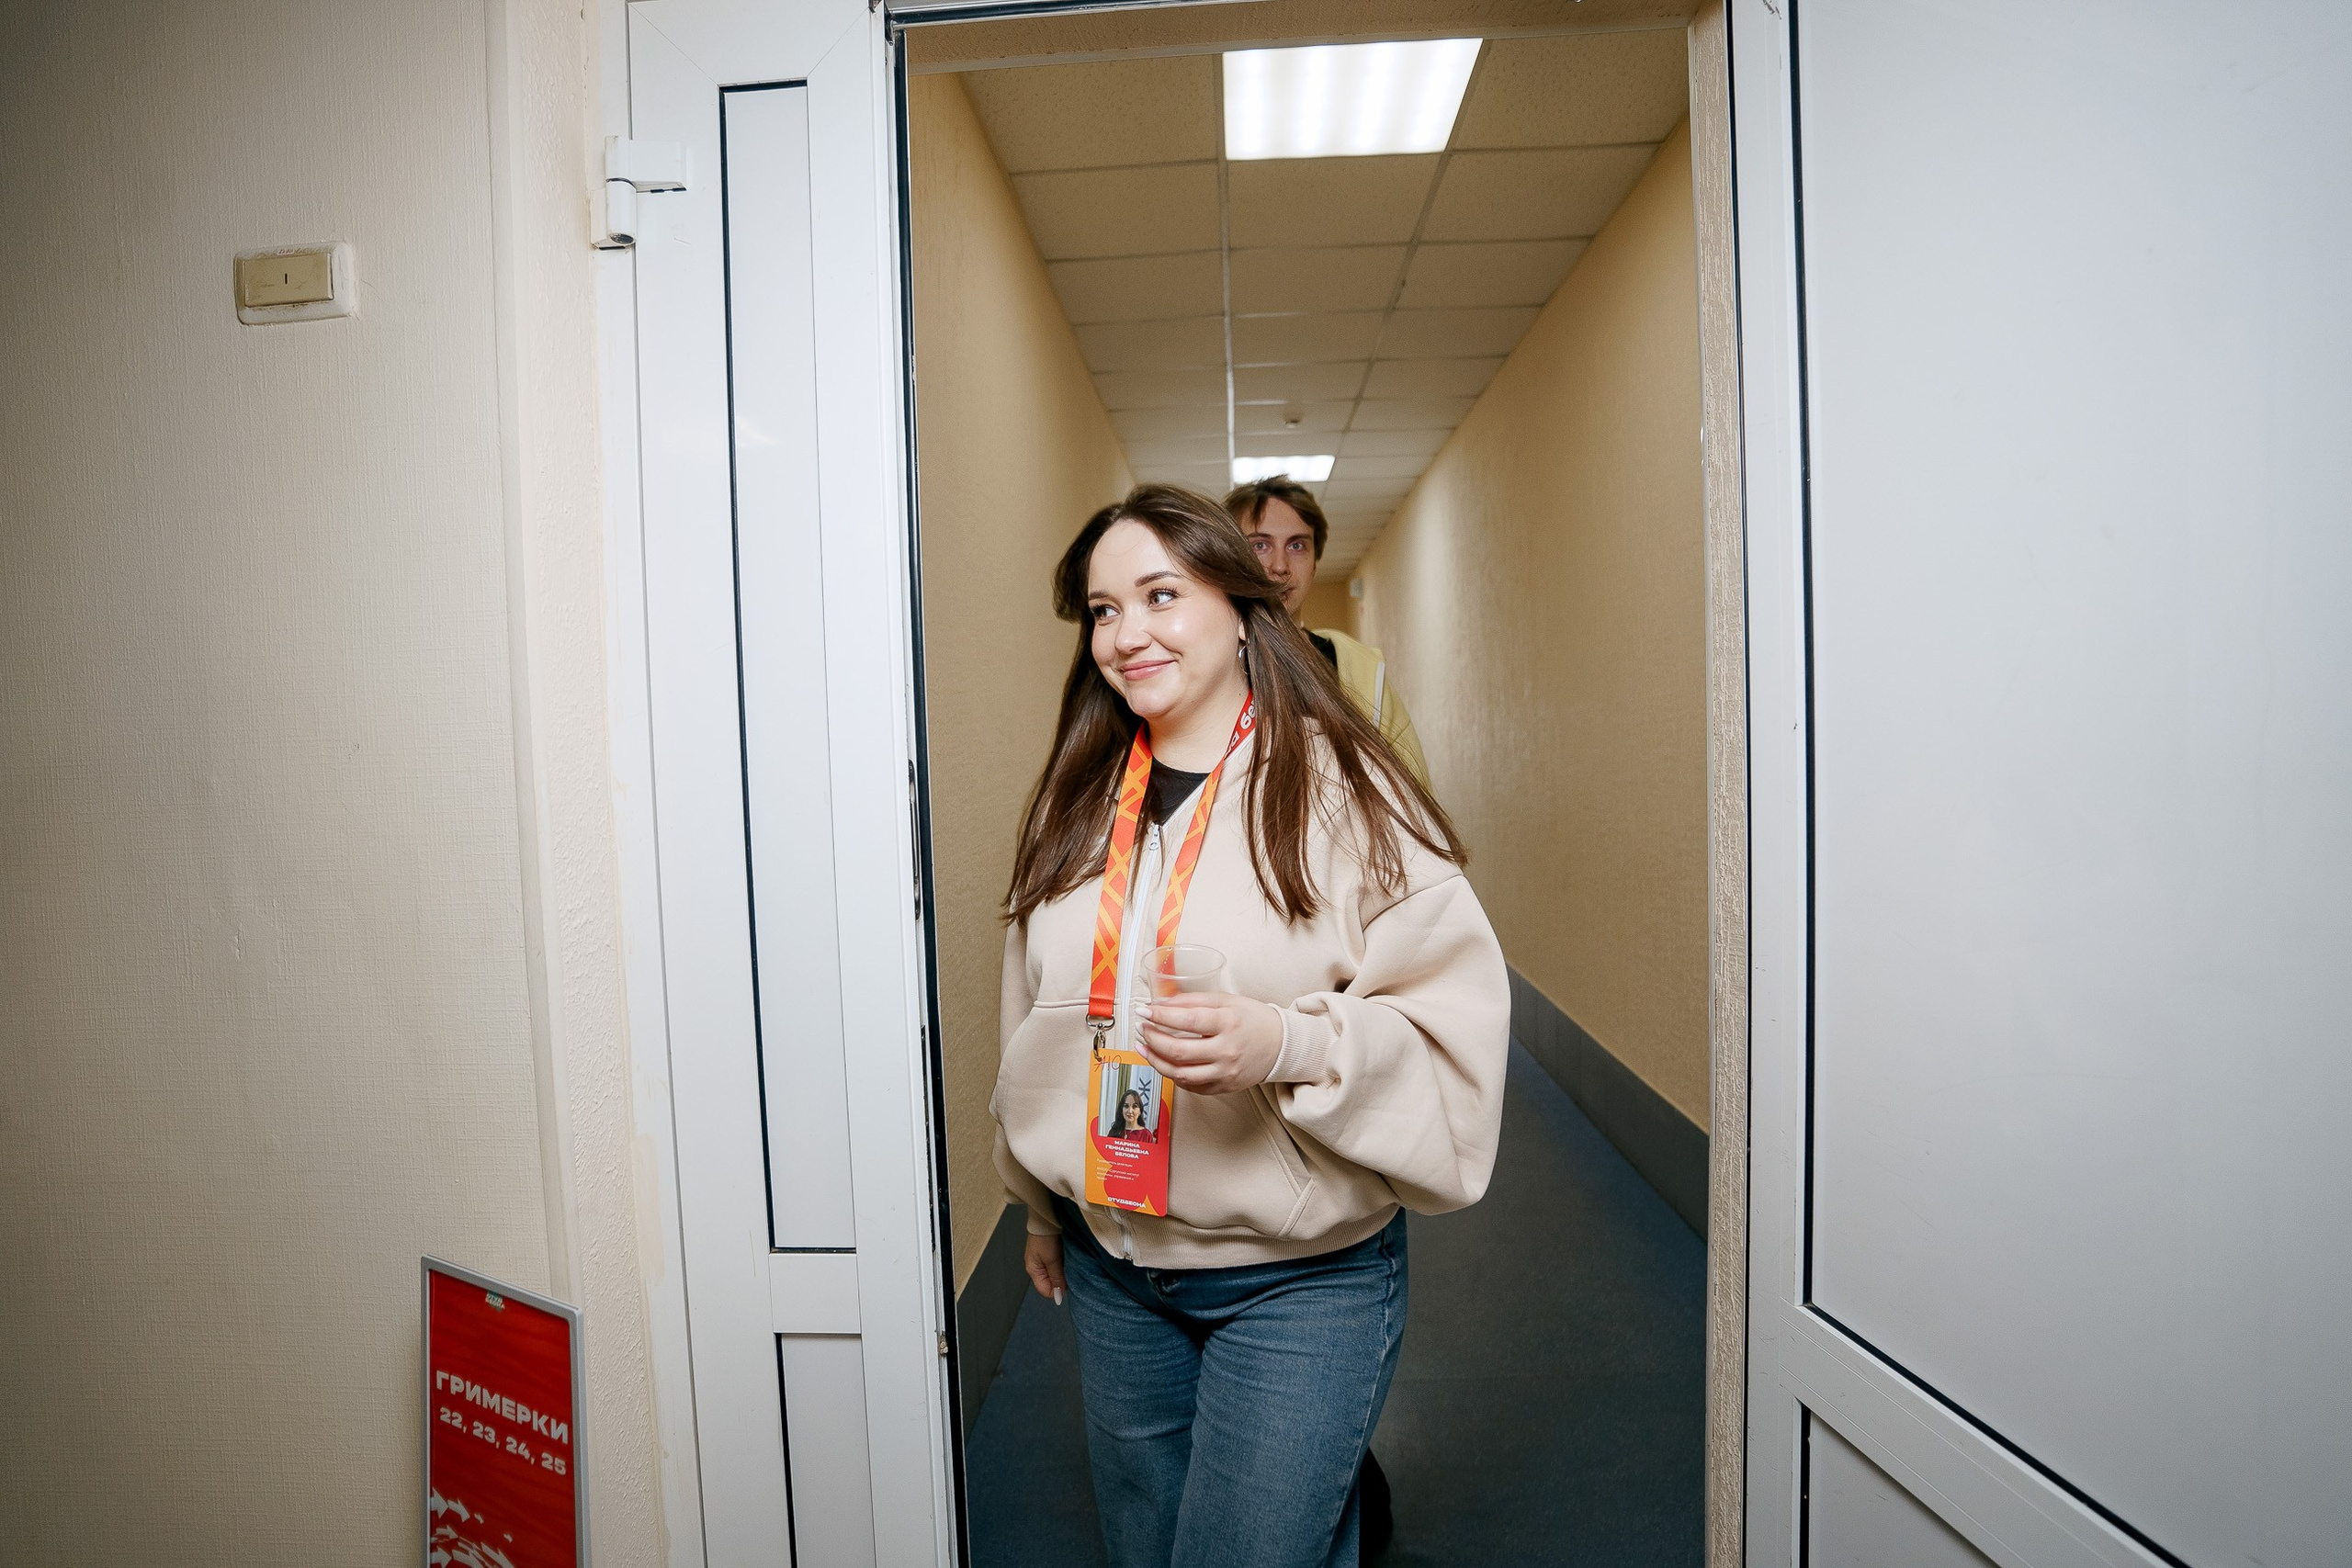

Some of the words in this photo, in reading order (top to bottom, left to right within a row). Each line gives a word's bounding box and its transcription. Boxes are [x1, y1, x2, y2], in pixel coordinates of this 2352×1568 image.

[1240, 700, 1257, 730] бе
[1105, 1145, 1148, 1155] ГЕННАДЬЕВНА
[436, 1371, 569, 1444] ГРИМЕРКИ
[439, 1406, 467, 1433] 22,
[472, 1420, 500, 1449] 23,
[505, 1436, 536, 1465] 24,
[541, 1451, 567, 1476] 25
